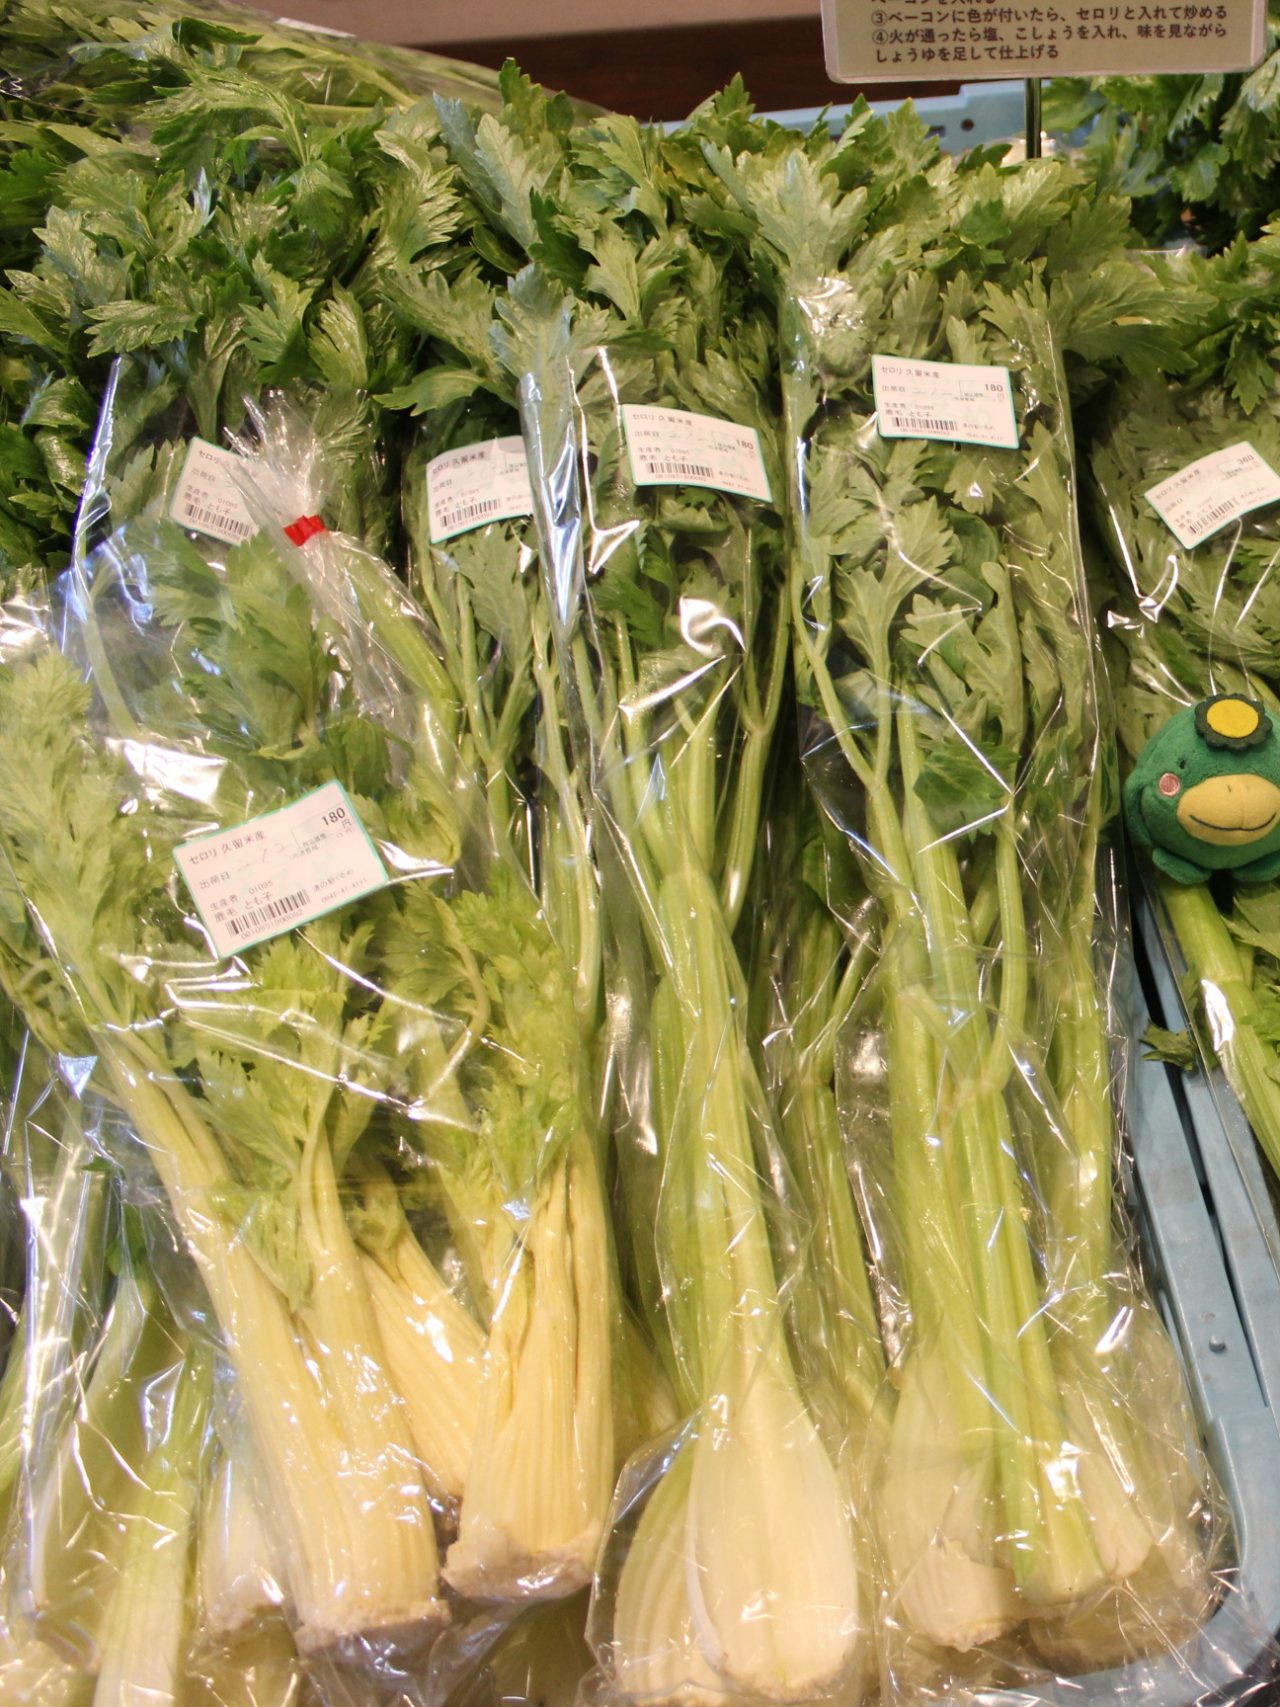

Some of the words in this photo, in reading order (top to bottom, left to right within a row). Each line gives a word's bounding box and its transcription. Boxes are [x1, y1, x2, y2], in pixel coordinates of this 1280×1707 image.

[876, 45, 1059, 63] しょうゆを足して仕上げる
[984, 383, 1004, 393] 180
[321, 806, 347, 827] 180
